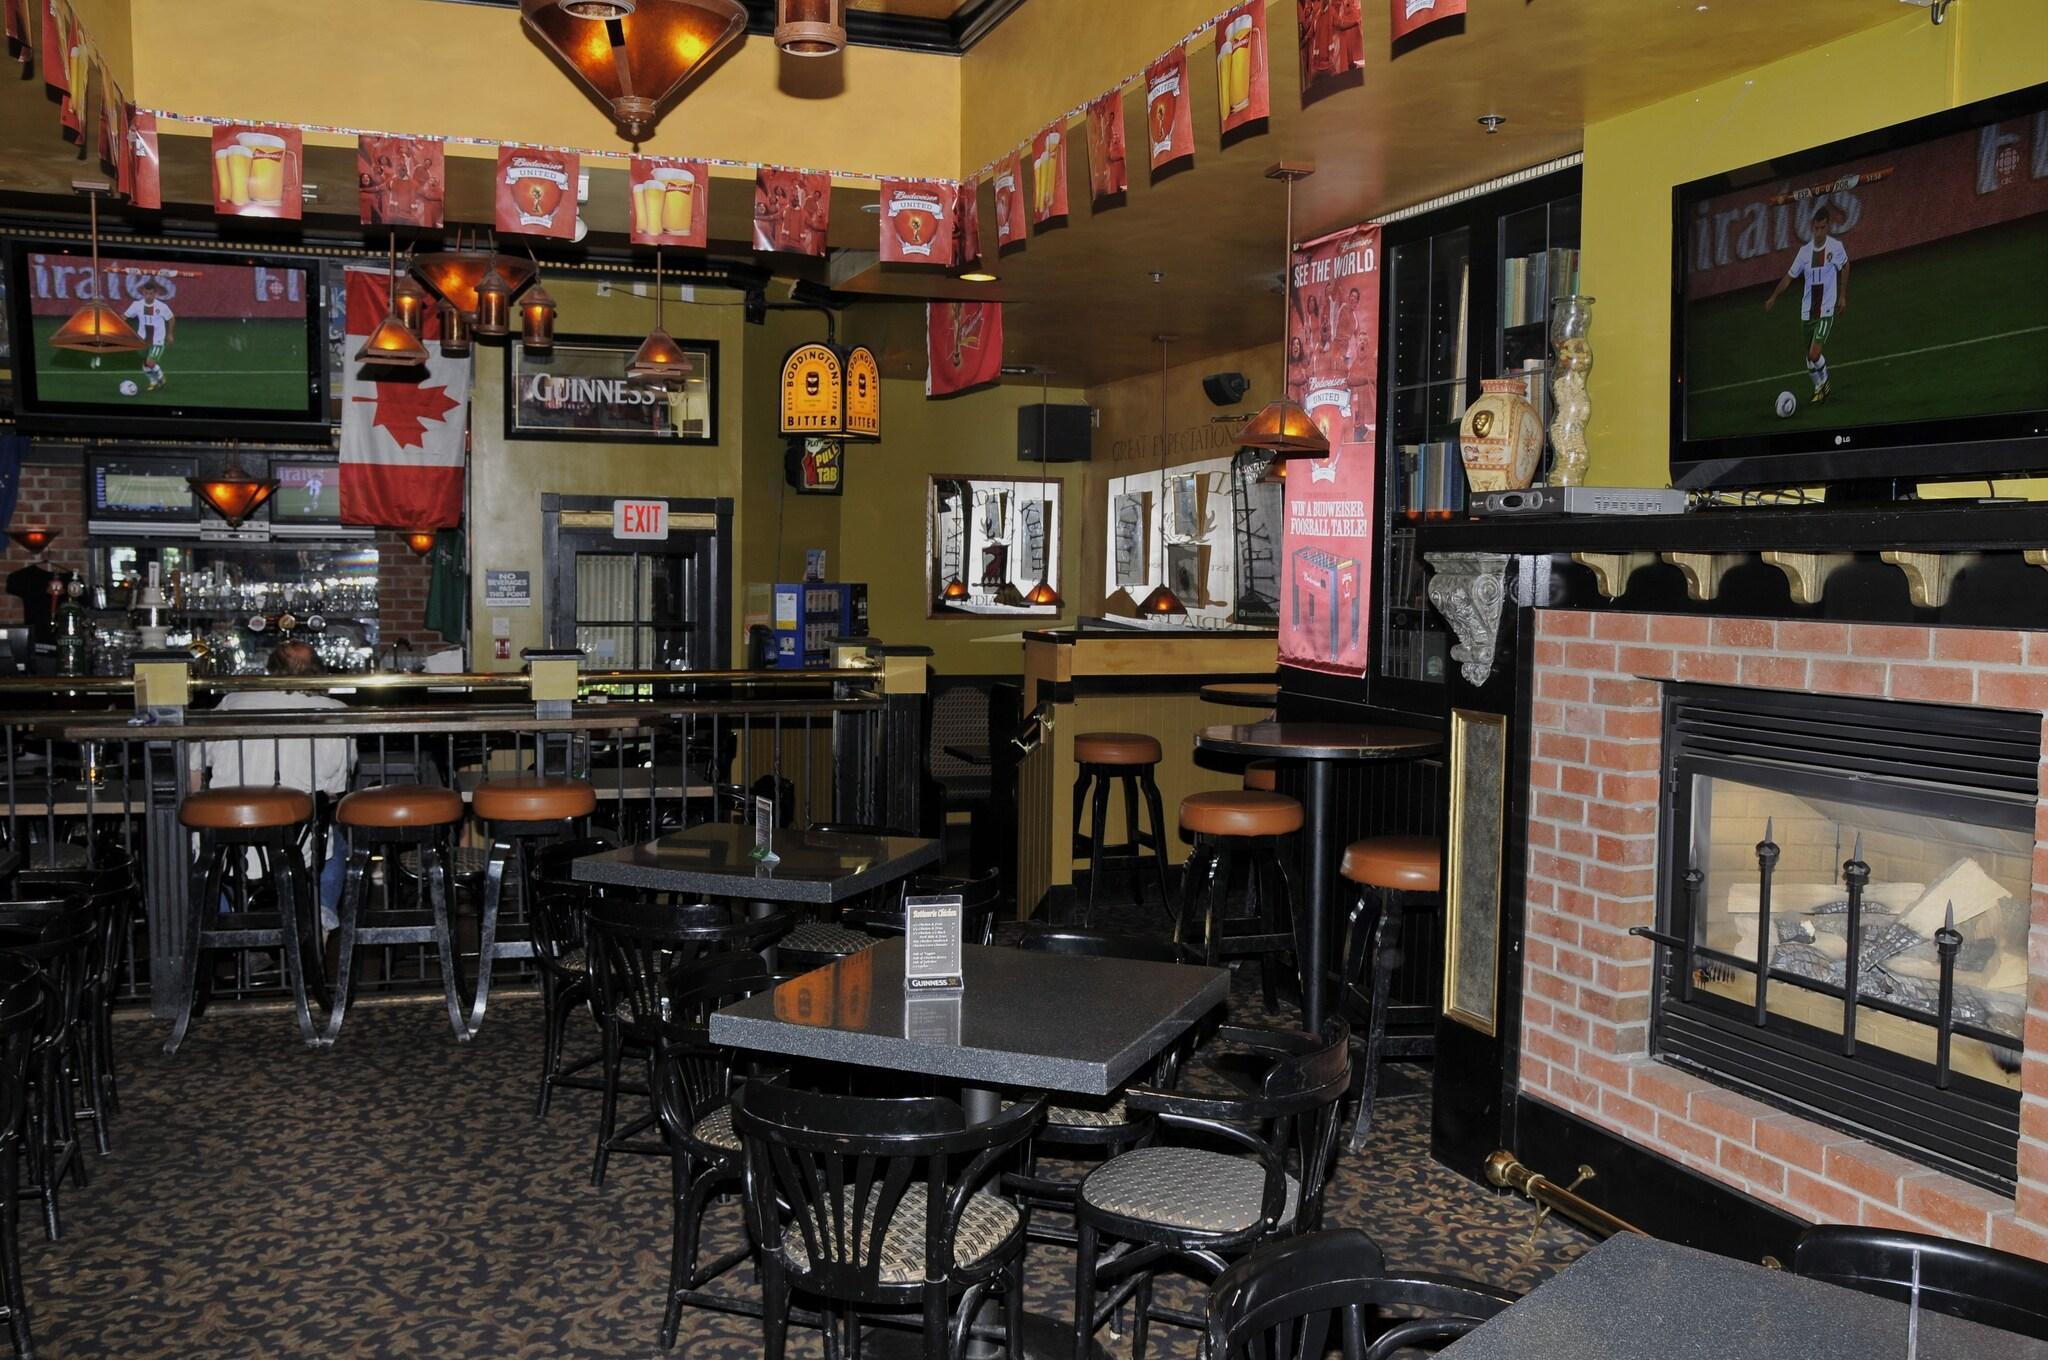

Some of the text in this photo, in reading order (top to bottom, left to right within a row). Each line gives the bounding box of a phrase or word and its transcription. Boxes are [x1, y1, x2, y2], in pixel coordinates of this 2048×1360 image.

[511, 157, 564, 170] Budweiser
[519, 169, 557, 180] UNITED
[893, 190, 938, 201] Budweiser
[900, 201, 933, 211] UNITED
[1294, 263, 1309, 288] SEE
[1310, 259, 1331, 284] THE
[1333, 247, 1378, 279] WORLD.
[787, 351, 840, 388] BODDINGTONS
[848, 352, 877, 391] BODDINGTONS
[532, 372, 656, 406] GUINNESS
[1313, 393, 1340, 403] UNITED
[787, 415, 838, 427] BITTER
[848, 415, 877, 429] BITTER
[1111, 435, 1146, 462] GREAT
[1290, 500, 1365, 518] WIN A BUDWEISER
[623, 504, 662, 534] EXIT
[1290, 518, 1367, 538] FOOSBALL TABLE!
[911, 979, 948, 987] GUINNESS
